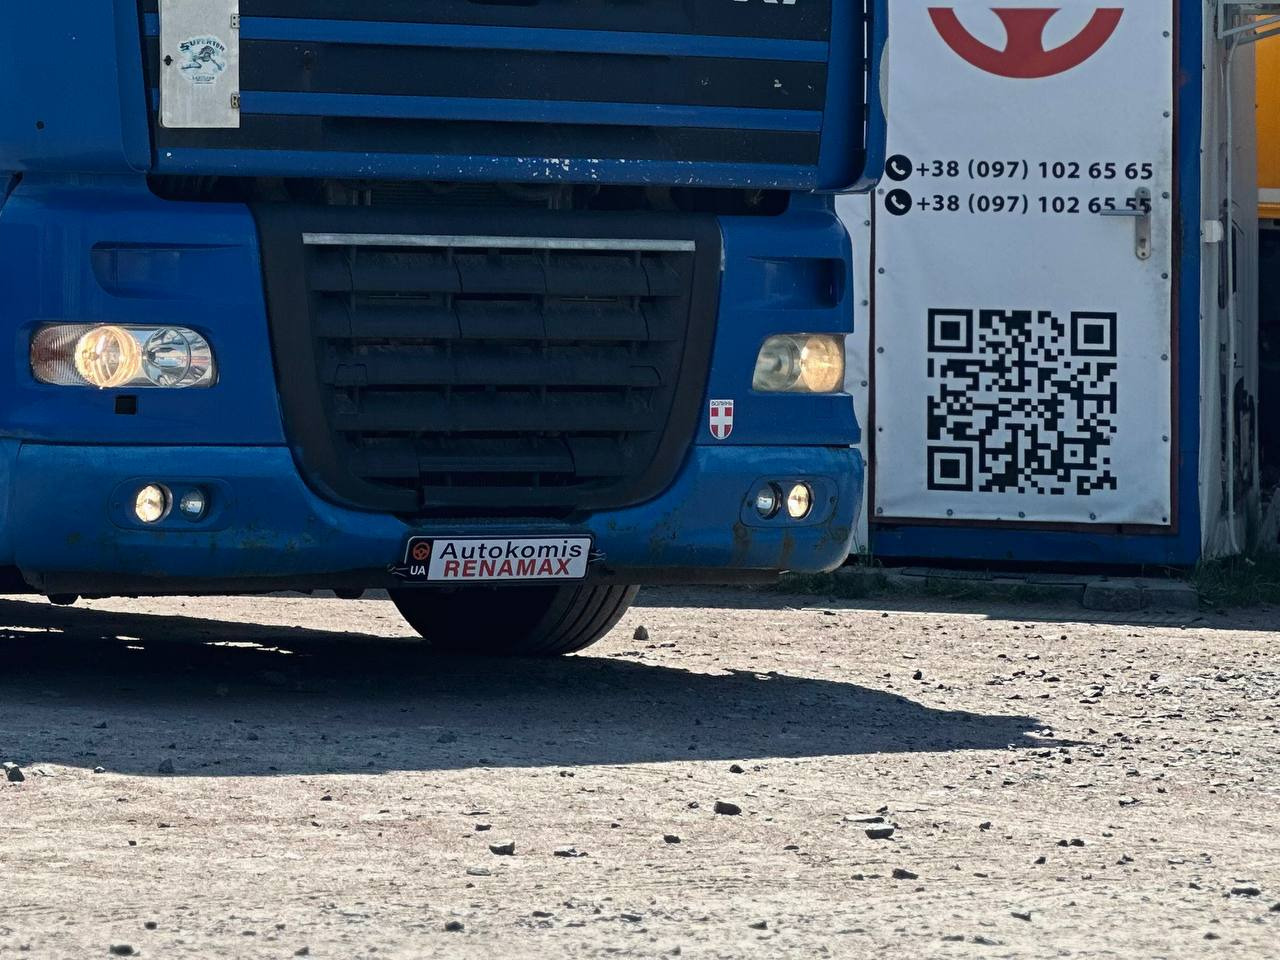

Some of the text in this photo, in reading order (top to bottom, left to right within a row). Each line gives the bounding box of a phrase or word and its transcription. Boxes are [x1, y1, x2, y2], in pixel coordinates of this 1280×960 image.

[916, 159, 1153, 180] +38 (097) 102 65 65
[917, 195, 960, 212] +38
[968, 193, 1029, 214] (097)
[1038, 196, 1080, 213] 102
[1088, 197, 1116, 214] 65
[439, 540, 583, 560] Autokomis
[410, 565, 426, 576] UA
[443, 558, 572, 578] RENAMAX
